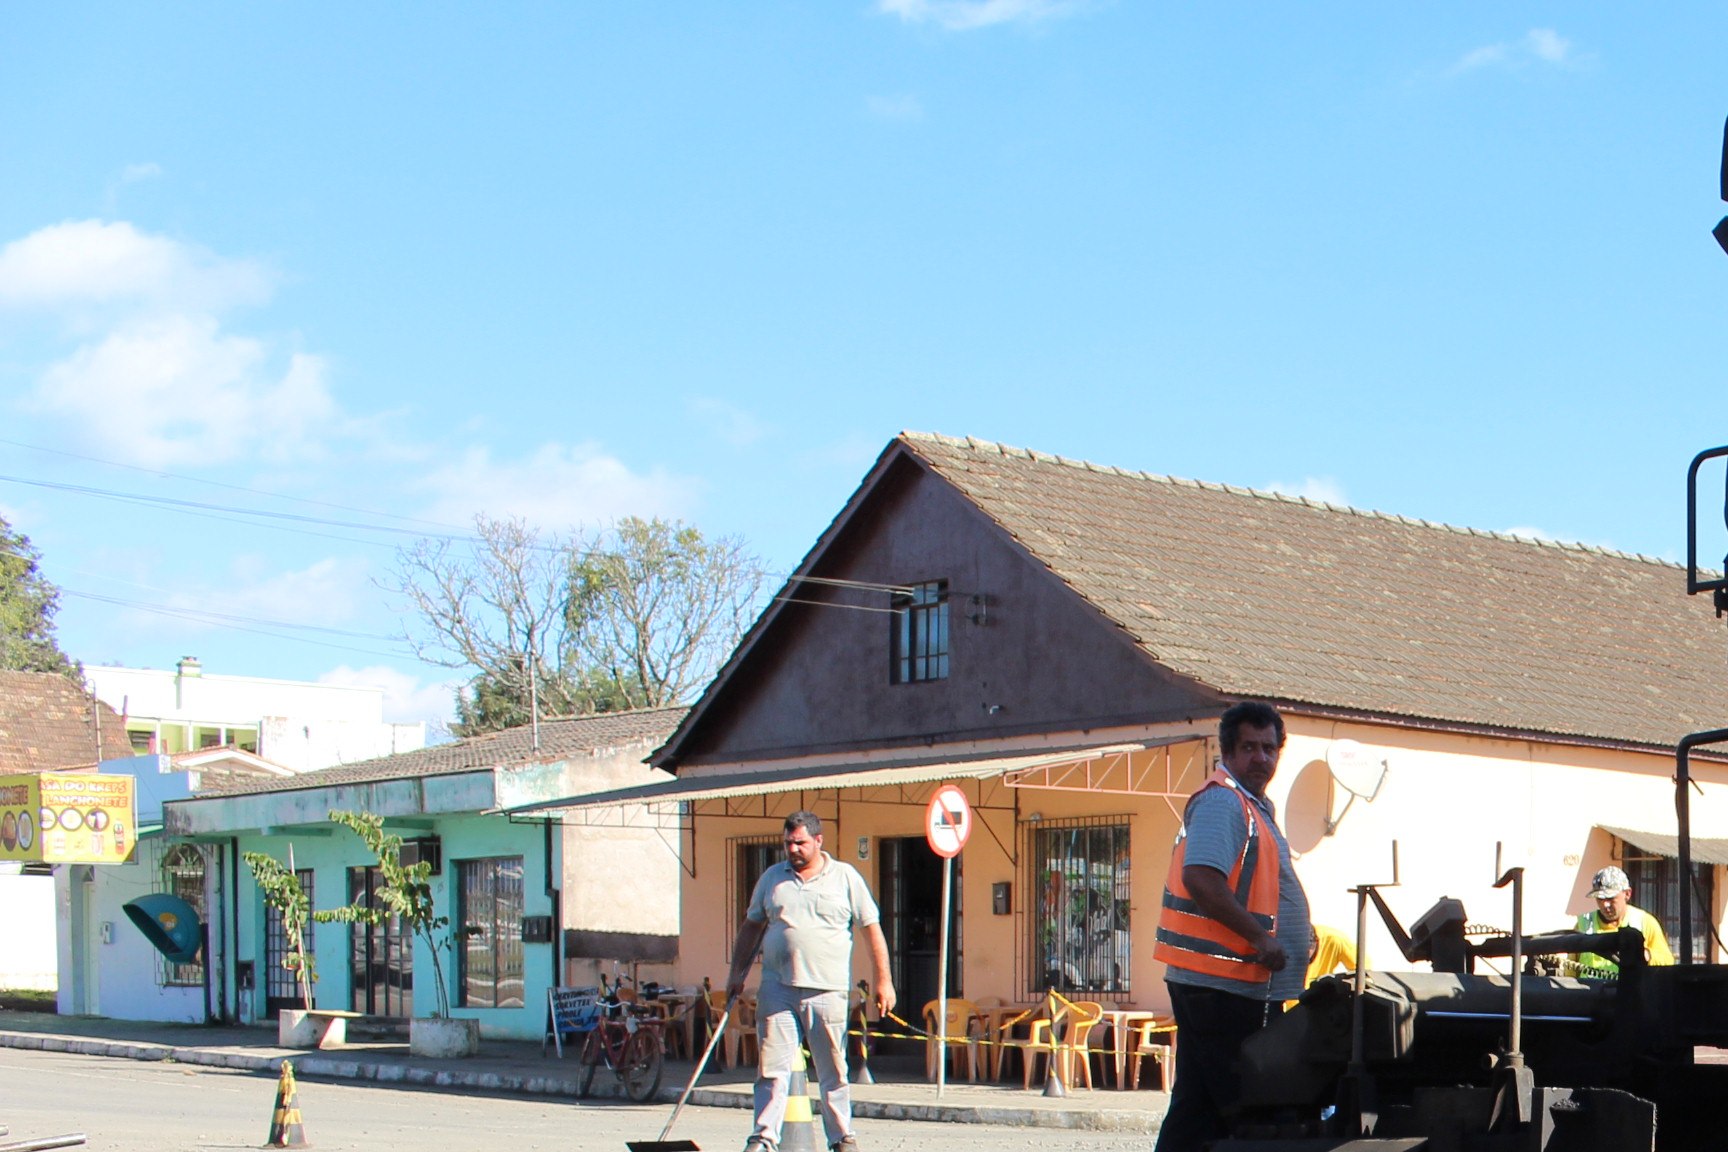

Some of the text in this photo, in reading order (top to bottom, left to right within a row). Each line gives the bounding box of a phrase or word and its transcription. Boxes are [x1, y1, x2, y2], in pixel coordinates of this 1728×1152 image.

[63, 780, 86, 791] DO
[88, 781, 128, 793] KREPS
[0, 785, 29, 806] ONETE
[45, 794, 128, 808] LANCHONETE
